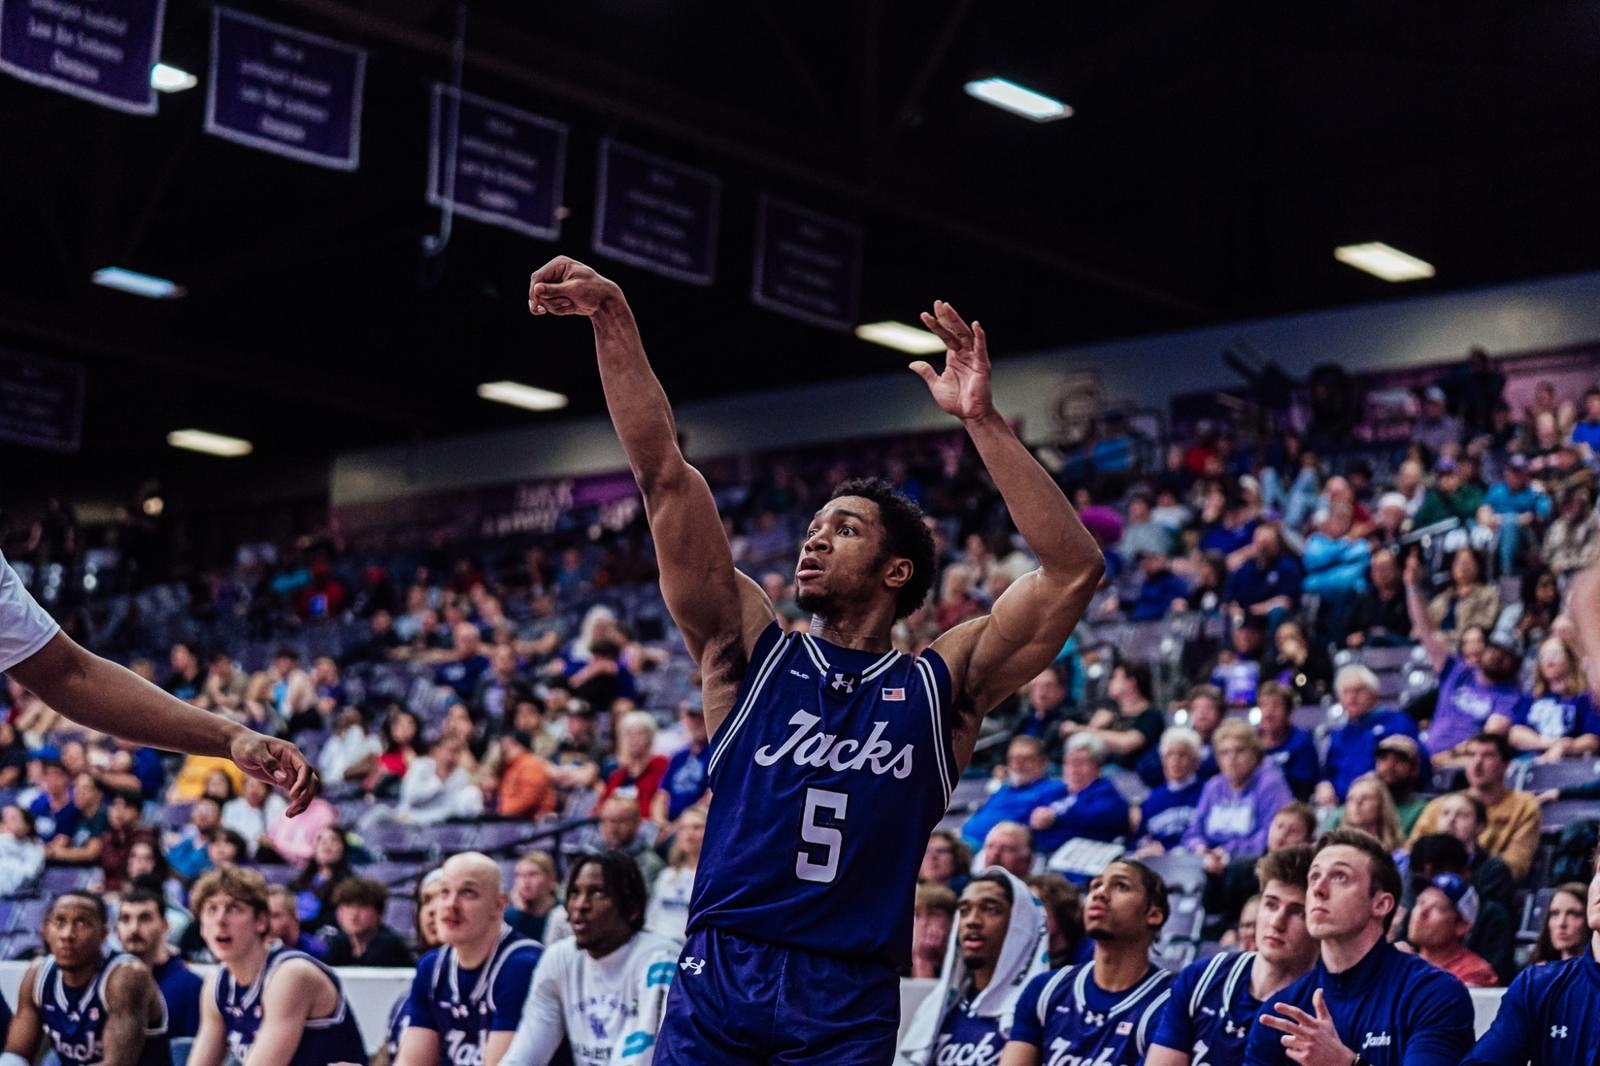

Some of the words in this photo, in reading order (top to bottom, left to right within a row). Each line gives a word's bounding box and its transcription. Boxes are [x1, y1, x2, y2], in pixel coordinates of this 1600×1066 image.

[754, 708, 915, 779] Jacks
[795, 787, 849, 883] 5
[937, 1032, 1004, 1066] Jack
[1044, 1036, 1128, 1066] Jak
[1362, 1031, 1391, 1050] Jacks
